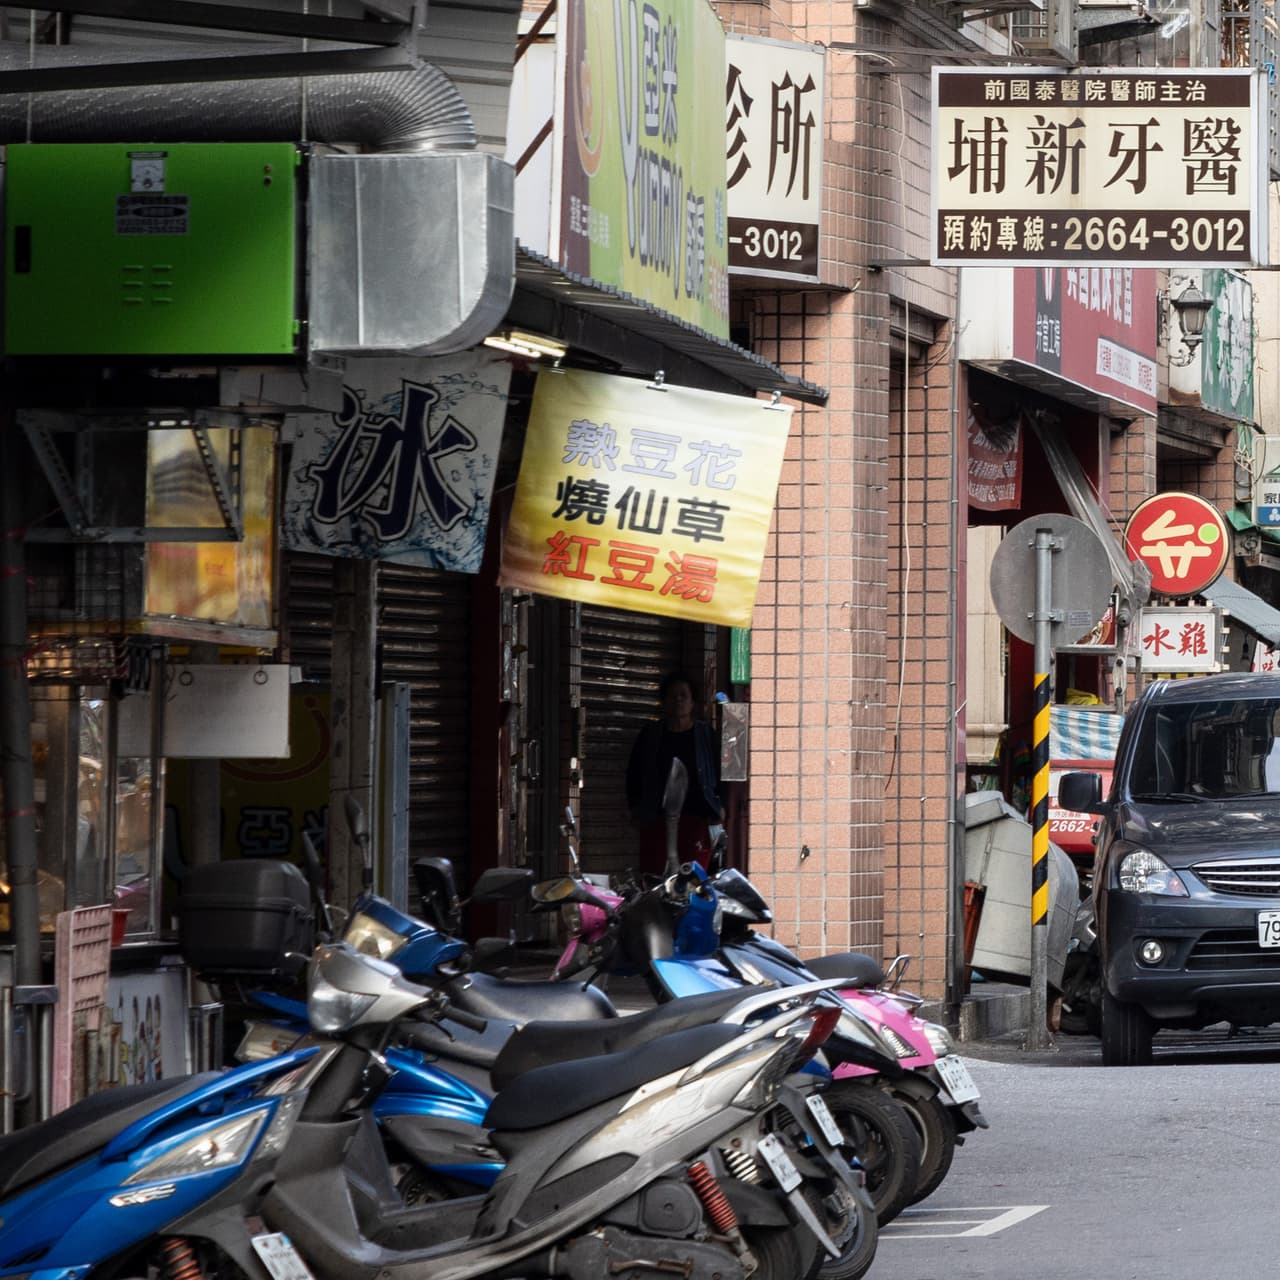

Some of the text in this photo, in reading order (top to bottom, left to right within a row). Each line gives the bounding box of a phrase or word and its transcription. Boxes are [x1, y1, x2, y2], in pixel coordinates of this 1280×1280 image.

[984, 79, 1206, 103] 前國泰醫院醫師主治
[947, 115, 1242, 196] 埔新牙醫
[308, 380, 477, 542] 冰
[562, 419, 743, 490] 熱豆花
[552, 476, 730, 542] 燒仙草
[542, 531, 718, 603] 紅豆湯
